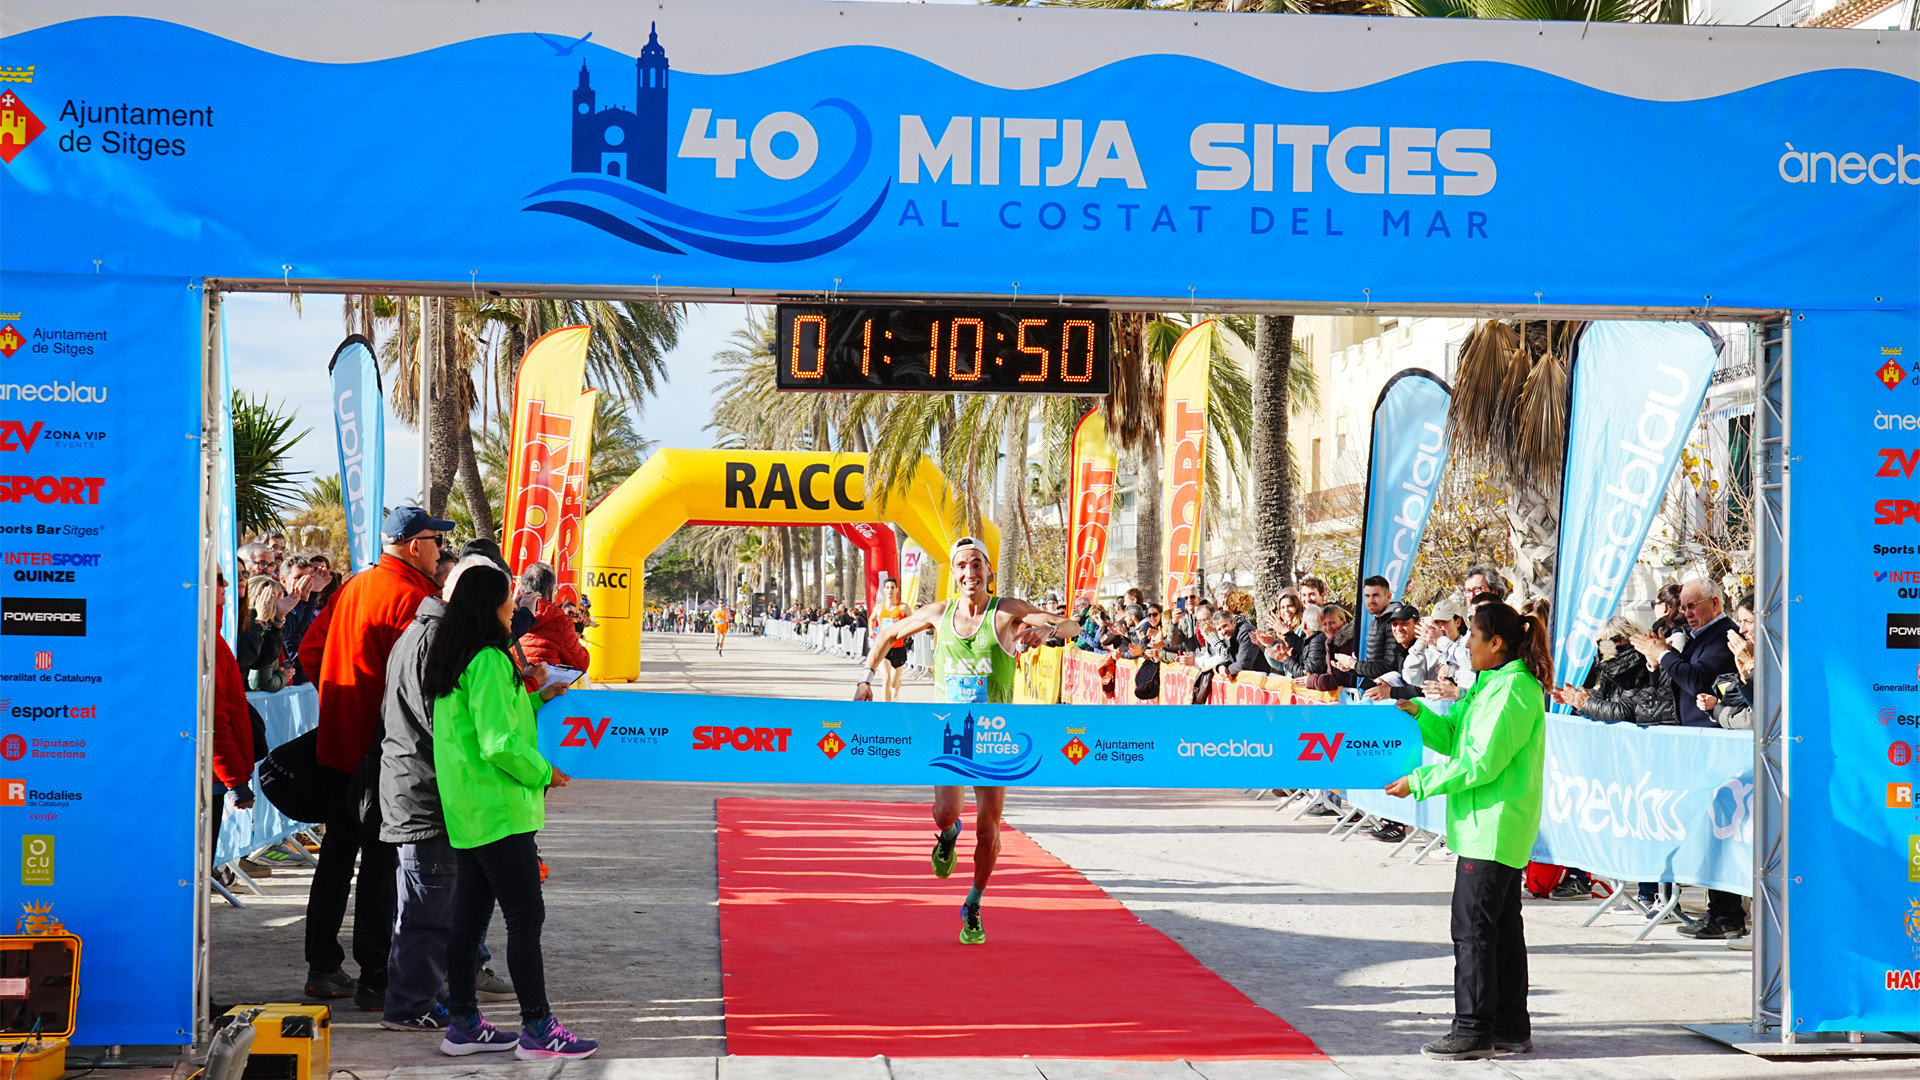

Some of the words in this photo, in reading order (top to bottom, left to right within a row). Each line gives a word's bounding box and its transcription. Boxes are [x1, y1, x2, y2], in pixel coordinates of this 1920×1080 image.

[59, 100, 214, 128] Ajuntament
[59, 129, 92, 152] de
[102, 130, 186, 161] Sitges
[677, 108, 819, 180] 40
[899, 114, 1148, 189] MITJA
[1189, 122, 1497, 196] SITGES
[898, 198, 960, 228] AL
[998, 201, 1212, 234] COSTAT
[1250, 206, 1344, 237] DEL
[1382, 209, 1489, 239] MAR
[32, 328, 108, 342] Ajuntament
[32, 342, 49, 354] de
[53, 343, 94, 357] Sitges
[791, 315, 1095, 382] 01:10:50
[44, 430, 82, 440] ZONA
[85, 431, 107, 441] VIP
[55, 441, 96, 449] EVENTS
[725, 461, 865, 511] RACC
[36, 524, 61, 535] Bar
[1873, 544, 1915, 555] Sports
[4, 552, 101, 567] INTERSPORT
[13, 569, 76, 583] QUINZE
[586, 571, 628, 589] RACC
[3, 611, 83, 622] POWERADE
[944, 657, 994, 675] LEA
[39, 673, 52, 682] de
[54, 673, 103, 684] Catalunya
[1873, 683, 1919, 692] Generalitat
[11, 704, 97, 721] esportcat
[976, 715, 1006, 730] 40
[559, 716, 612, 750] ZV
[610, 726, 646, 736] ZONA
[649, 726, 669, 737] VIP
[976, 731, 1012, 743] MITJA
[31, 738, 86, 749] Diputació
[620, 736, 658, 744] EVENTS
[692, 725, 792, 752] SPORT
[851, 733, 912, 745] Ajuntament
[1094, 738, 1155, 751] Ajuntament
[1345, 740, 1380, 749] ZONA
[1382, 740, 1402, 749] VIP
[31, 749, 86, 759] Barcelona
[850, 746, 866, 756] de
[867, 746, 901, 758] Sitges
[975, 743, 1019, 755] SITGES
[1177, 738, 1273, 758] ànecblau
[1297, 732, 1346, 763] ZV
[1356, 749, 1393, 757] EVENTS
[1094, 751, 1108, 762] de
[1111, 751, 1144, 764] Sitges
[8, 782, 25, 800] R
[29, 790, 82, 801] Rodalies
[1896, 786, 1911, 802] R
[29, 812, 58, 822] renfe
